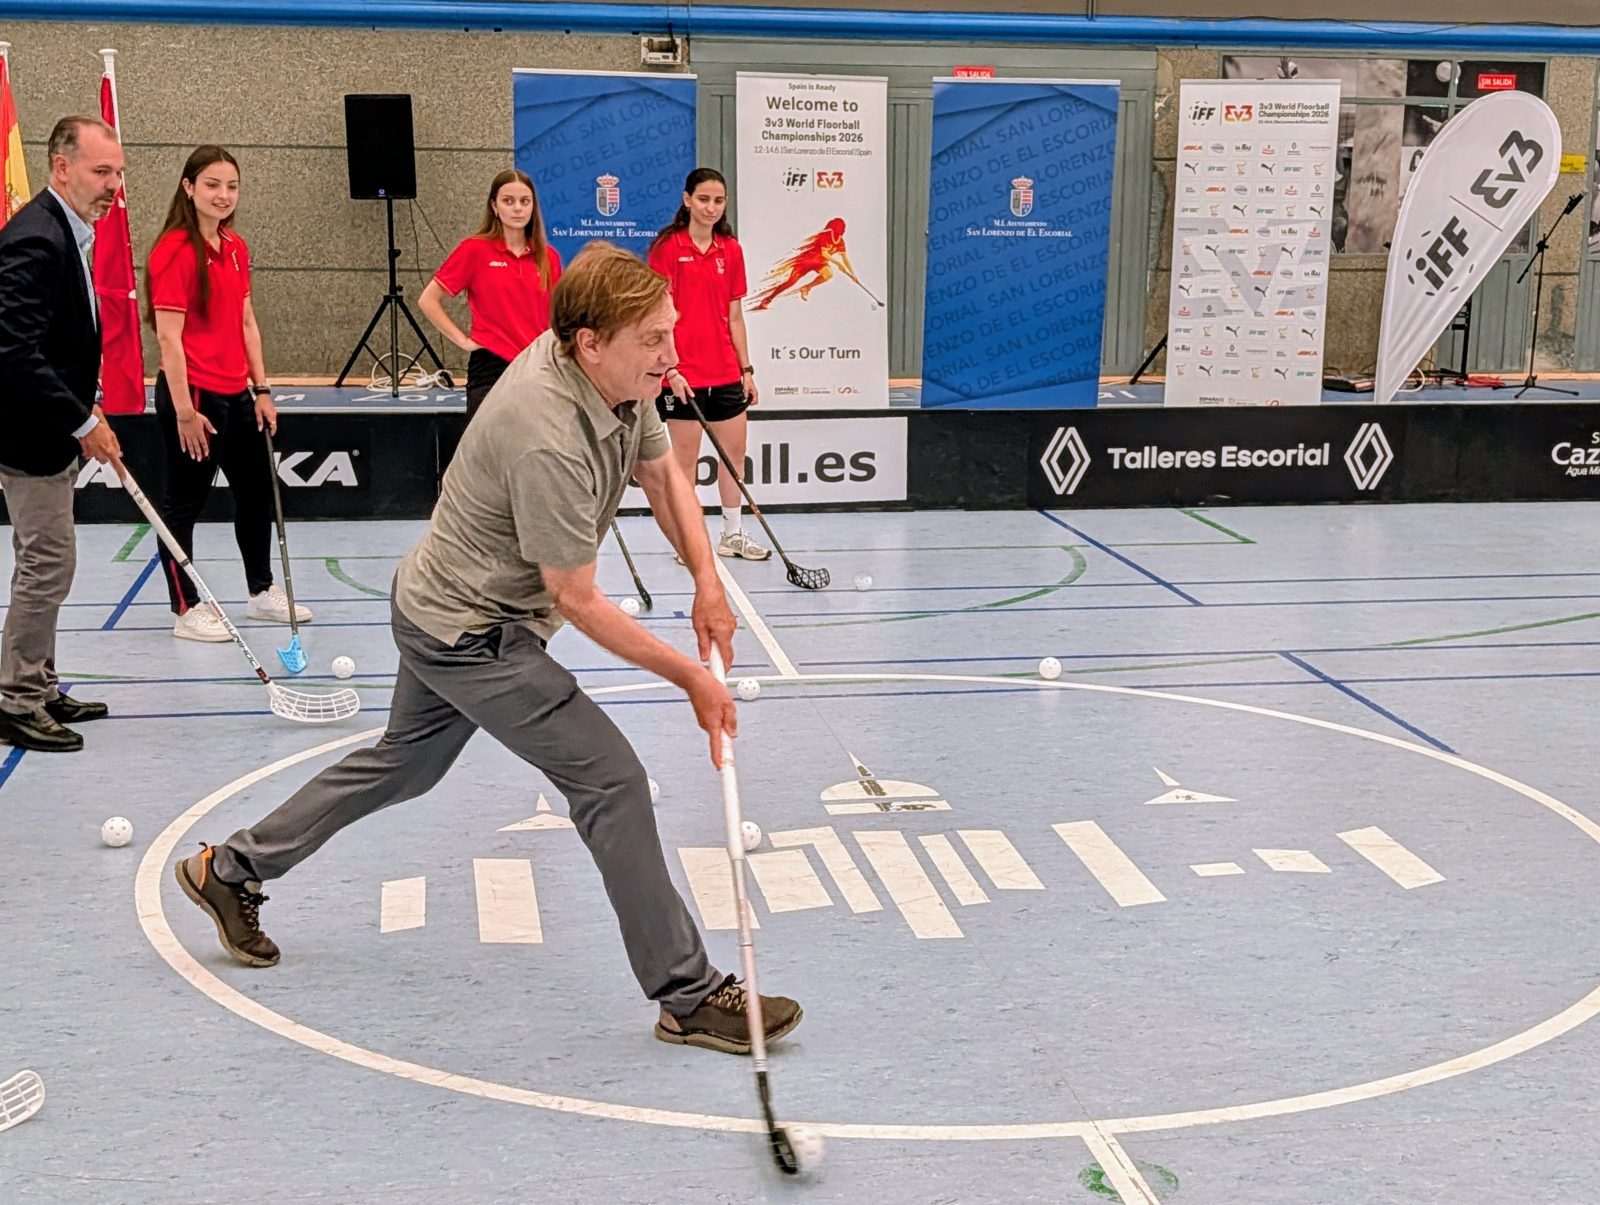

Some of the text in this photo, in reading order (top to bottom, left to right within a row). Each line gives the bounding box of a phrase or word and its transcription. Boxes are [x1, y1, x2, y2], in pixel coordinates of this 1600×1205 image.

[788, 83, 807, 91] Spain
[816, 84, 836, 92] Ready
[1492, 78, 1512, 86] SALIDA
[766, 97, 859, 112] Welcome to
[1258, 111, 1310, 119] Championships
[764, 118, 860, 130] 3v3 World Floorball
[761, 130, 864, 143] Championships 2026
[799, 346, 825, 360] Our
[828, 347, 861, 360] Turn
[1107, 442, 1331, 470] Talleres Escorial
[1565, 466, 1588, 477] Agua
